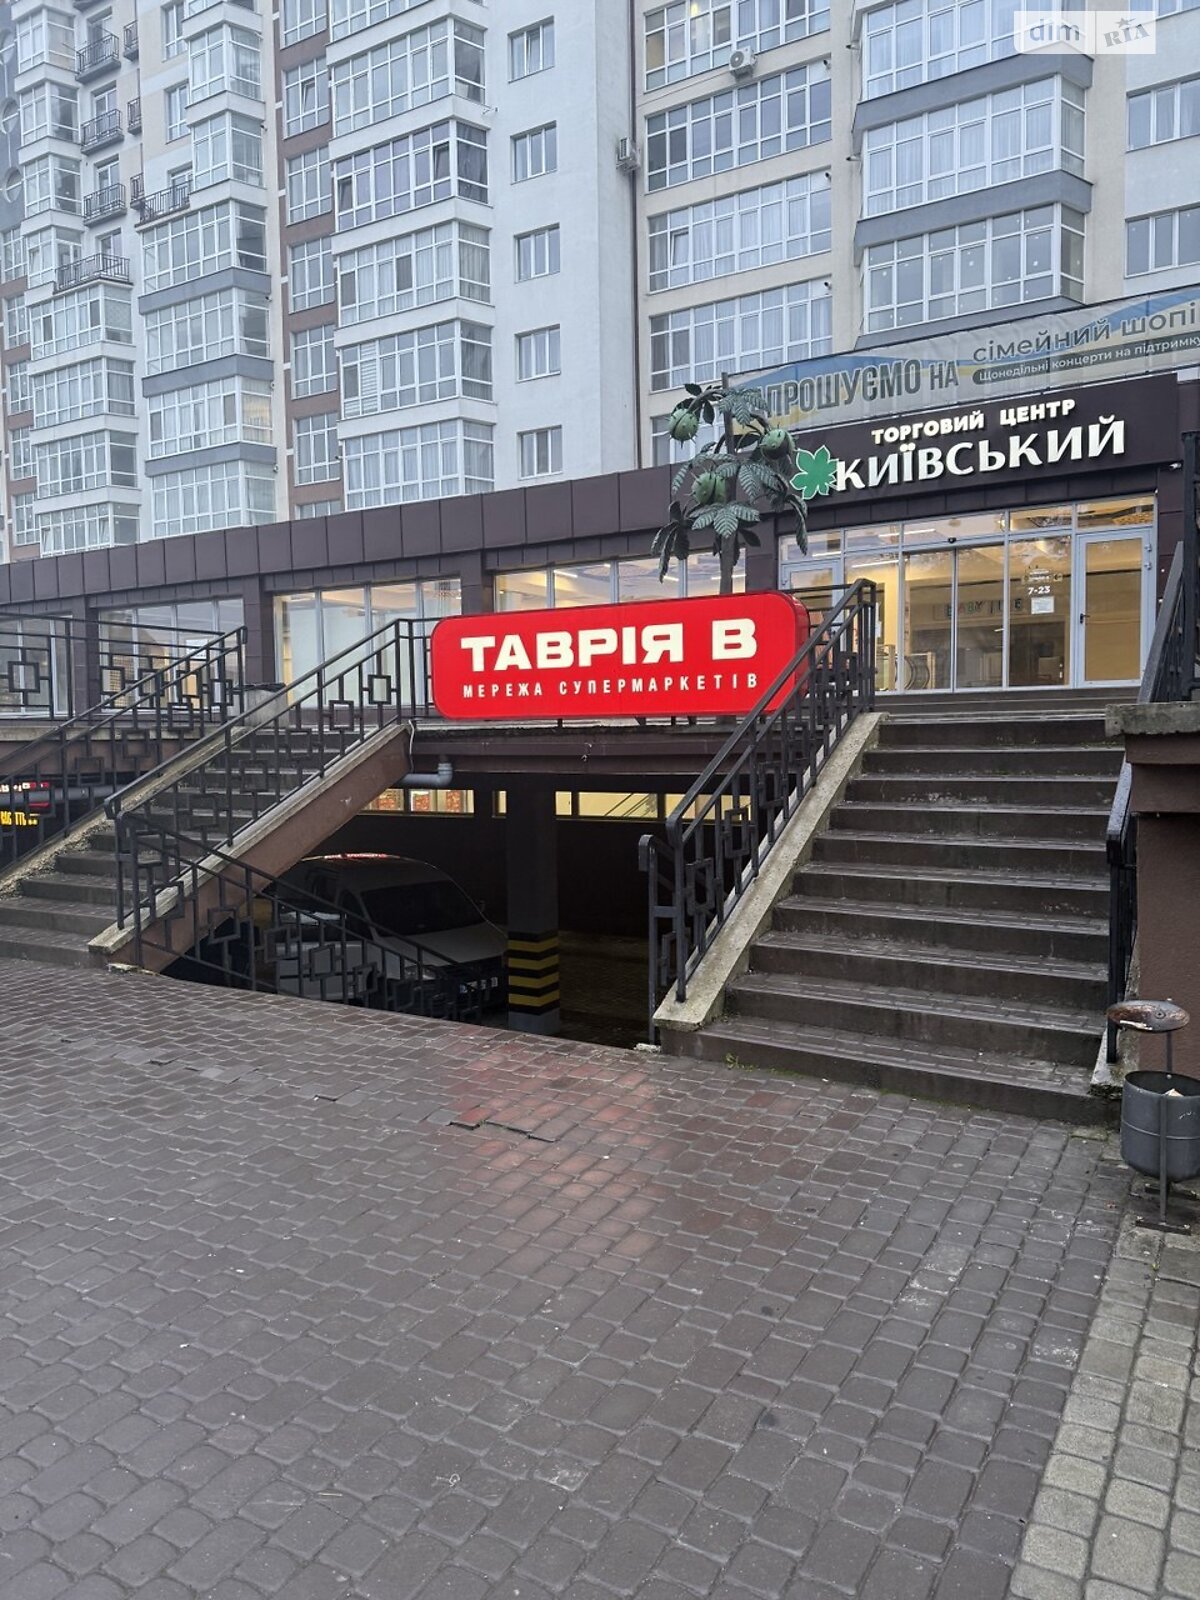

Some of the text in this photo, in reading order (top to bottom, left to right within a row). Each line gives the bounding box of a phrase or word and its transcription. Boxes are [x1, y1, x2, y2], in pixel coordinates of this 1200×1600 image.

[972, 317, 1111, 363] сімейний
[979, 357, 1049, 382] Щонедільні
[1051, 351, 1112, 370] концерти
[1115, 347, 1131, 358] на
[757, 359, 960, 418] ПРОШУЄМО НА
[871, 399, 1076, 445] ТОРГОВИЙ ЦЕНТР
[834, 415, 1127, 491] КИЇВСЬКИЙ
[1028, 585, 1051, 595] 7-23
[460, 618, 758, 672] ТАВРІЯ В
[463, 673, 758, 699] МЕРЕЖА СУПЕРМАРКЕТІВ
